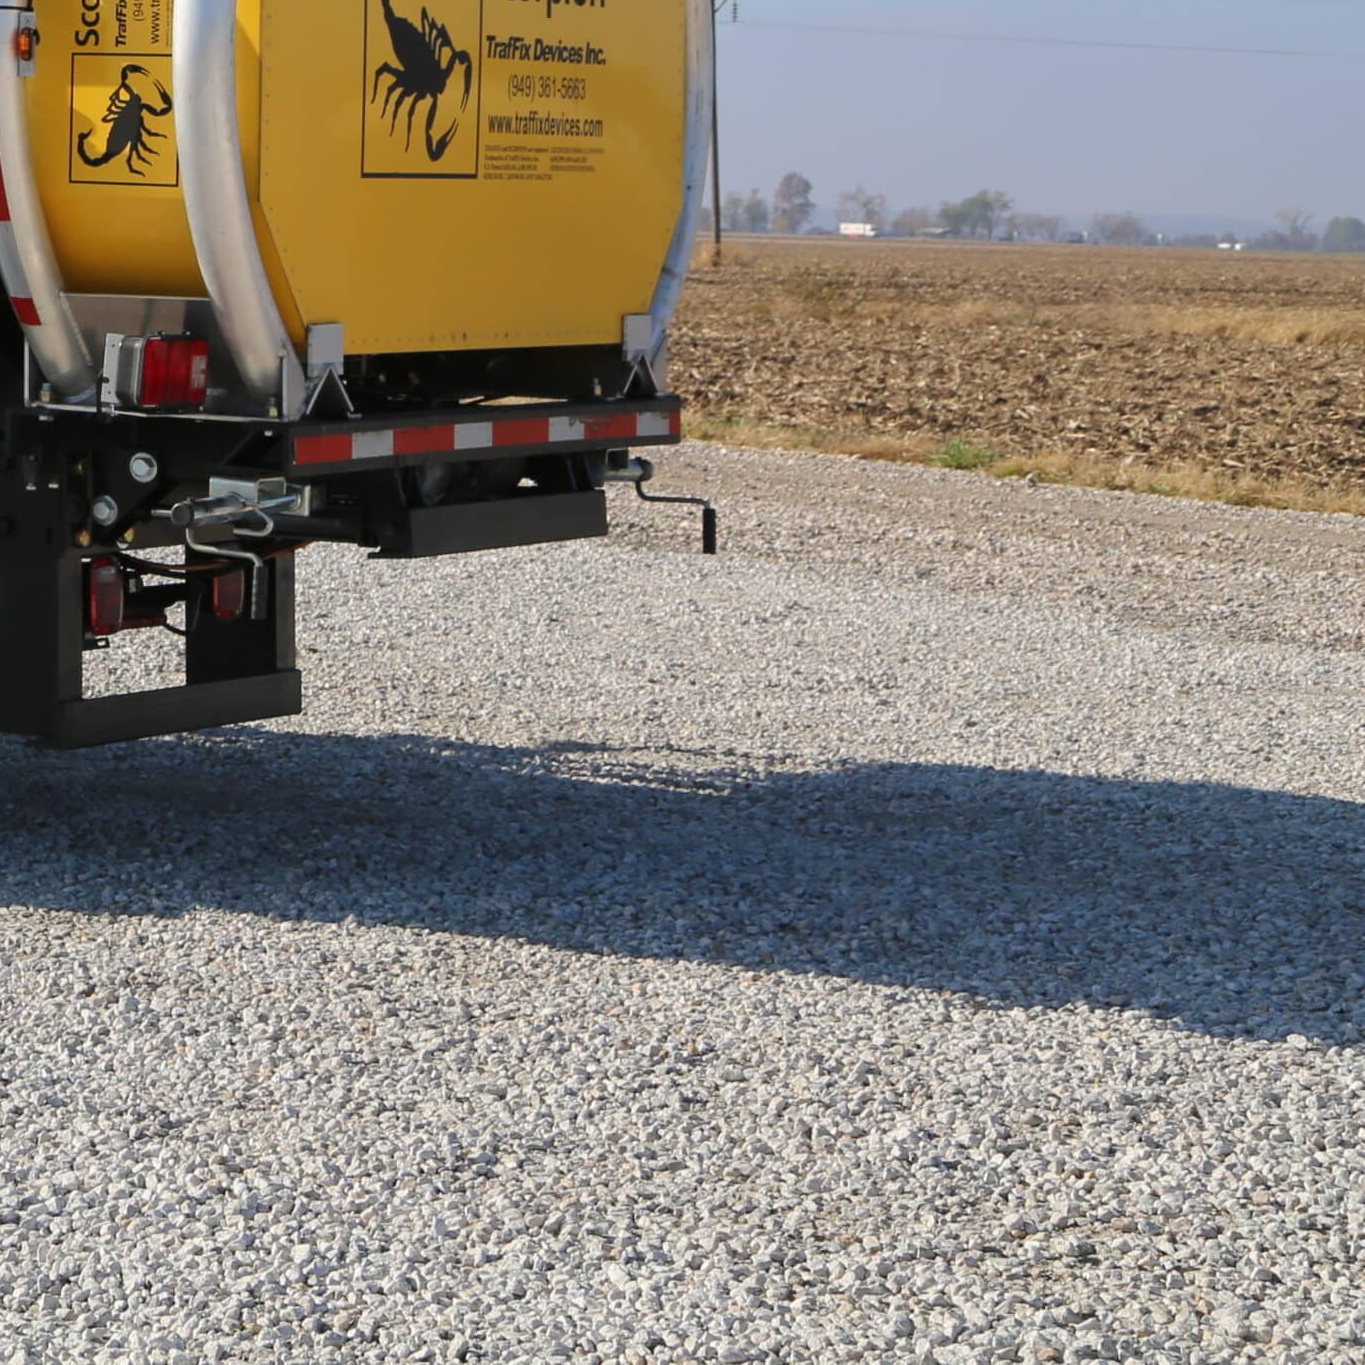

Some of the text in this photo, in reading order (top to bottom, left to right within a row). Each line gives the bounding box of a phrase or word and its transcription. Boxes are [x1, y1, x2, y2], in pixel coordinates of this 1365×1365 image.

[533, 37, 584, 63] Devices
[585, 41, 606, 65] Inc.
[508, 74, 586, 102] (949) 361-5663
[488, 111, 603, 137] www.traffixdevices.com
